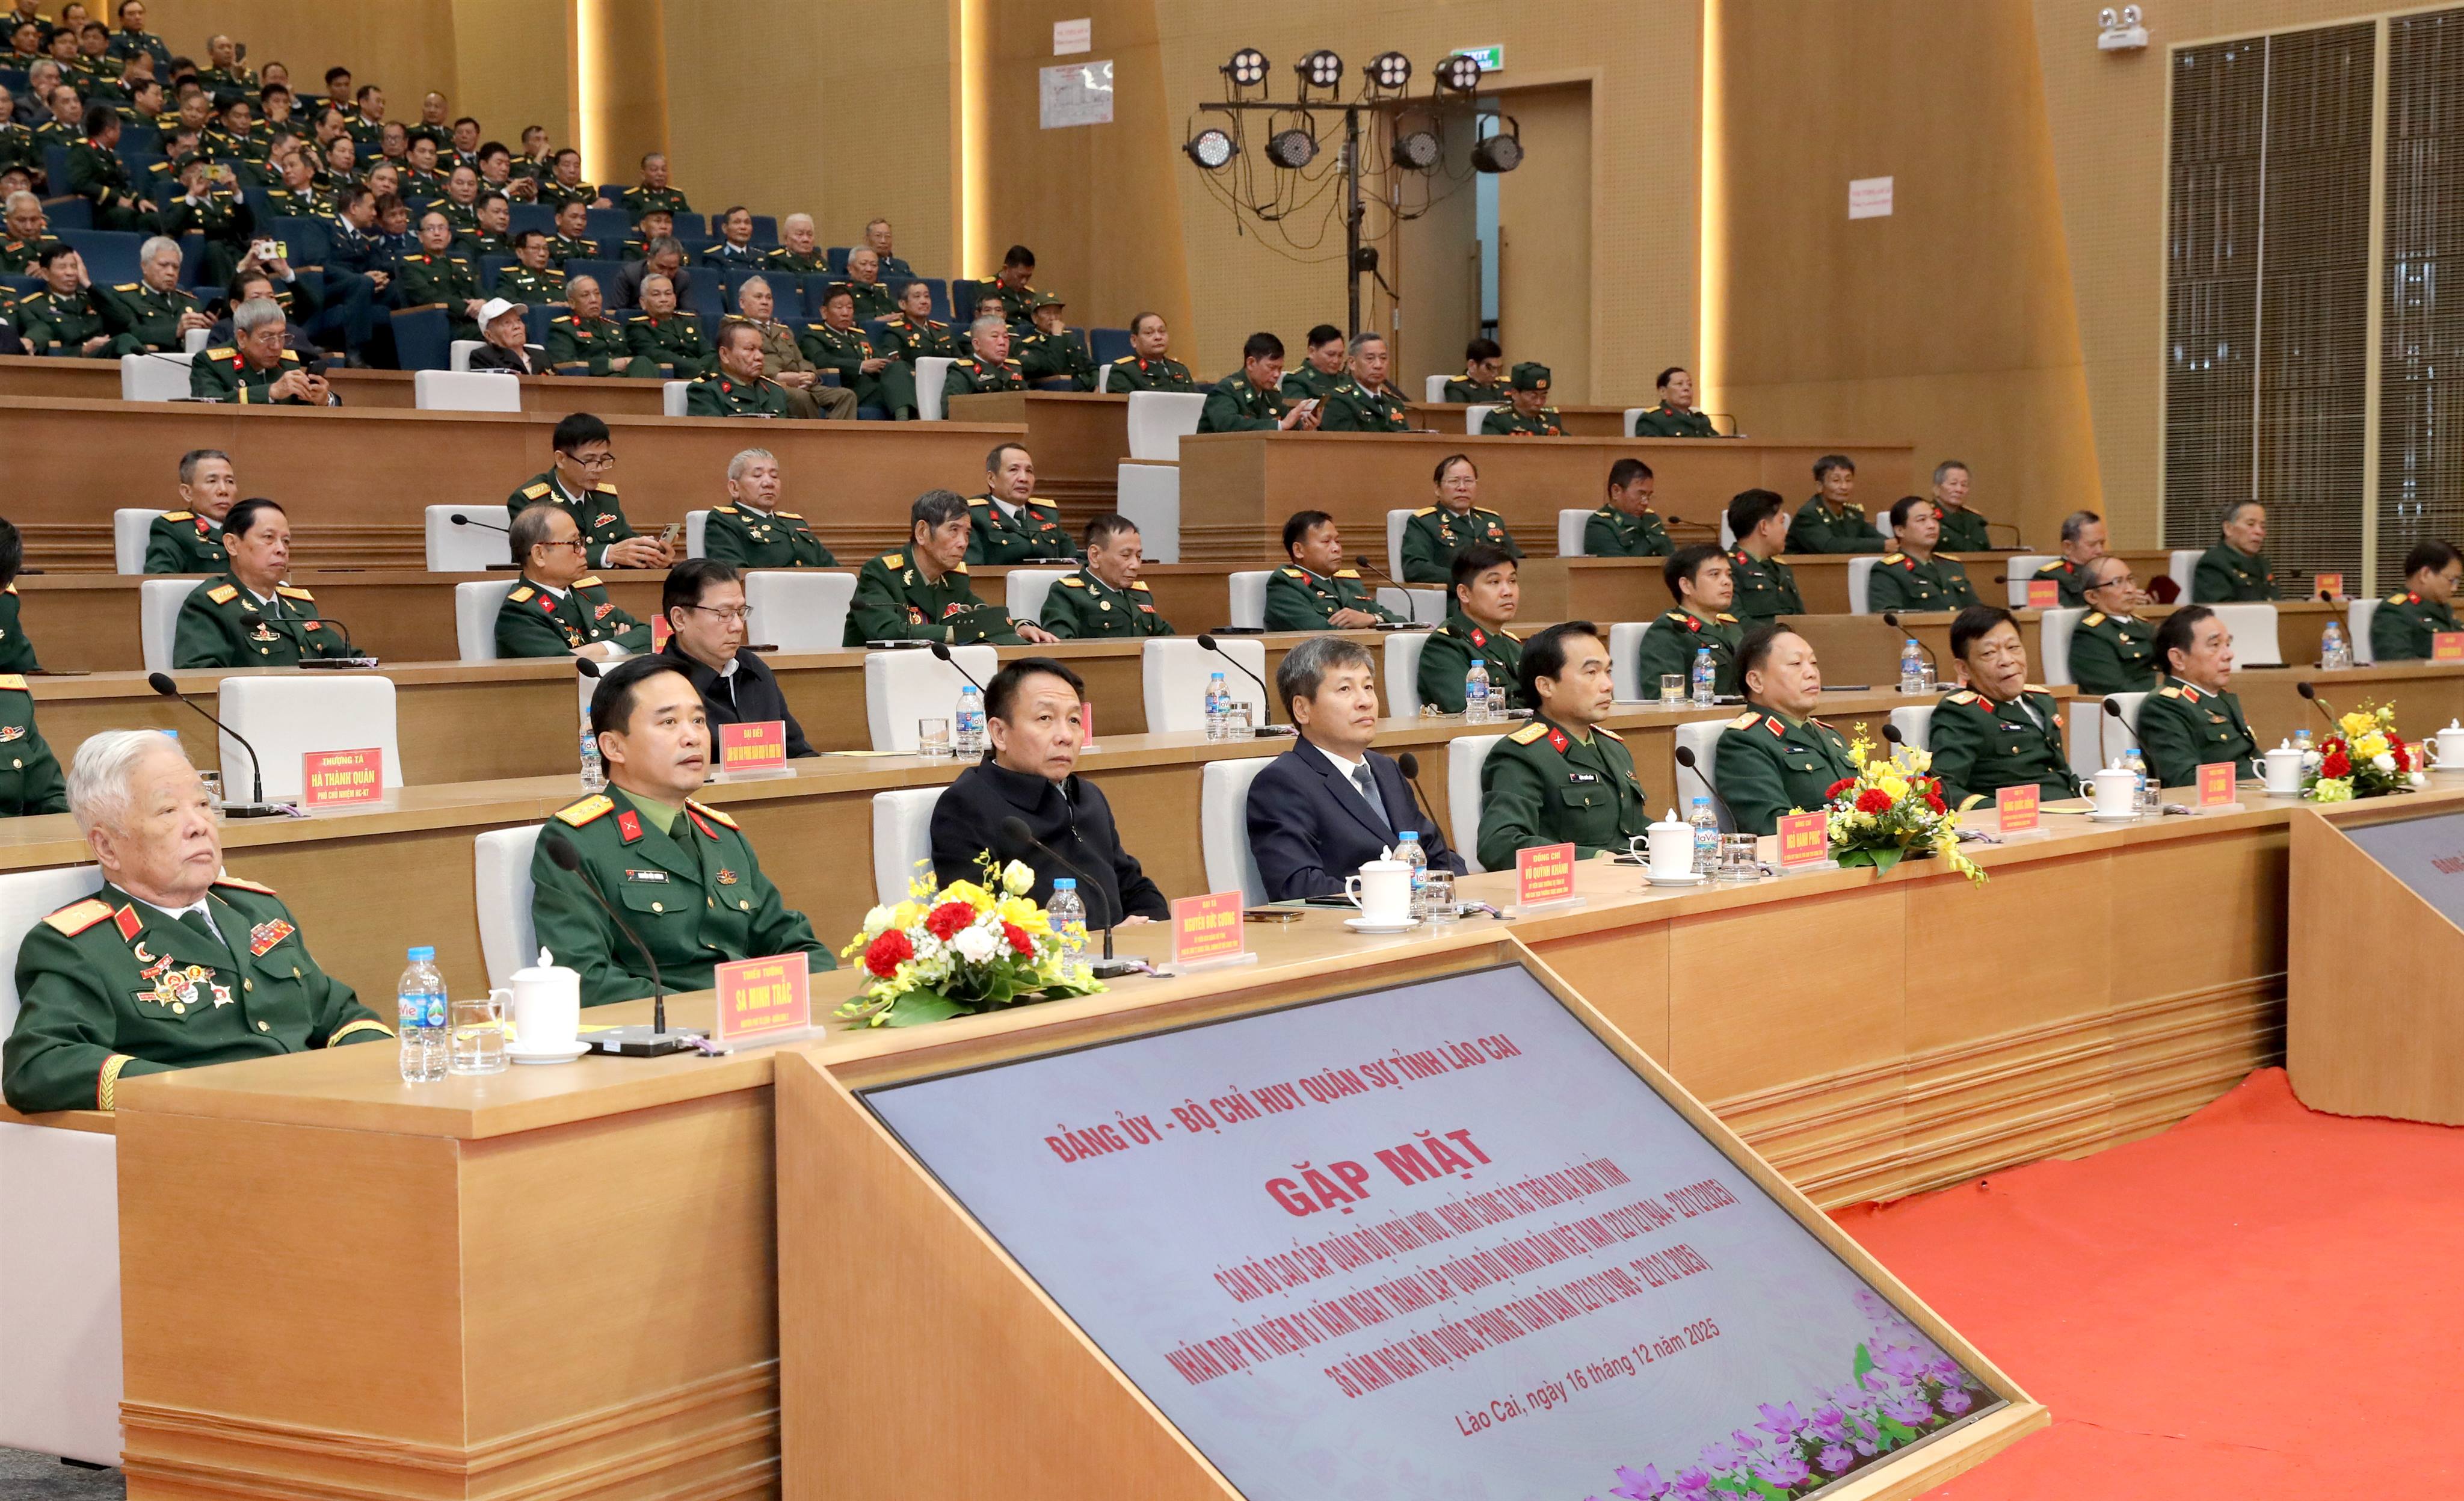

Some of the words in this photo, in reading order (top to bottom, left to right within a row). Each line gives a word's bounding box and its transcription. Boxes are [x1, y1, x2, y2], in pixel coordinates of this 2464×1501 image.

[312, 771, 322, 787] HÀ
[325, 769, 350, 786] THÀNH
[353, 768, 374, 785] QUÂN
[322, 756, 352, 766] THƯỢNG
[354, 754, 363, 763] TÁ
[736, 989, 747, 1011] SA
[1044, 1123, 1130, 1163] ĐẢNG
[1115, 1111, 1163, 1145] ỦY
[1171, 1099, 1220, 1134] BỘ
[1210, 1086, 1261, 1124] CHỈ
[1250, 1082, 1305, 1114] HUY
[1299, 1068, 1369, 1103] QUÂN
[1359, 1059, 1403, 1090] SỰ
[1388, 1050, 1449, 1080] TỈNH
[1437, 1041, 1486, 1070] LÀO
[1477, 1032, 1521, 1059] CAI
[1265, 1160, 1370, 1216] GẶP
[1373, 1129, 1491, 1186] MẶT
[1455, 1411, 1491, 1436] Lào
[1490, 1395, 1527, 1422] Cai,
[1526, 1381, 1568, 1410] ngày
[1566, 1369, 1588, 1390] 16
[1586, 1355, 1636, 1383] tháng
[1631, 1343, 1653, 1364] 12
[1652, 1335, 1686, 1357] năm
[1684, 1318, 1720, 1345] 2025
